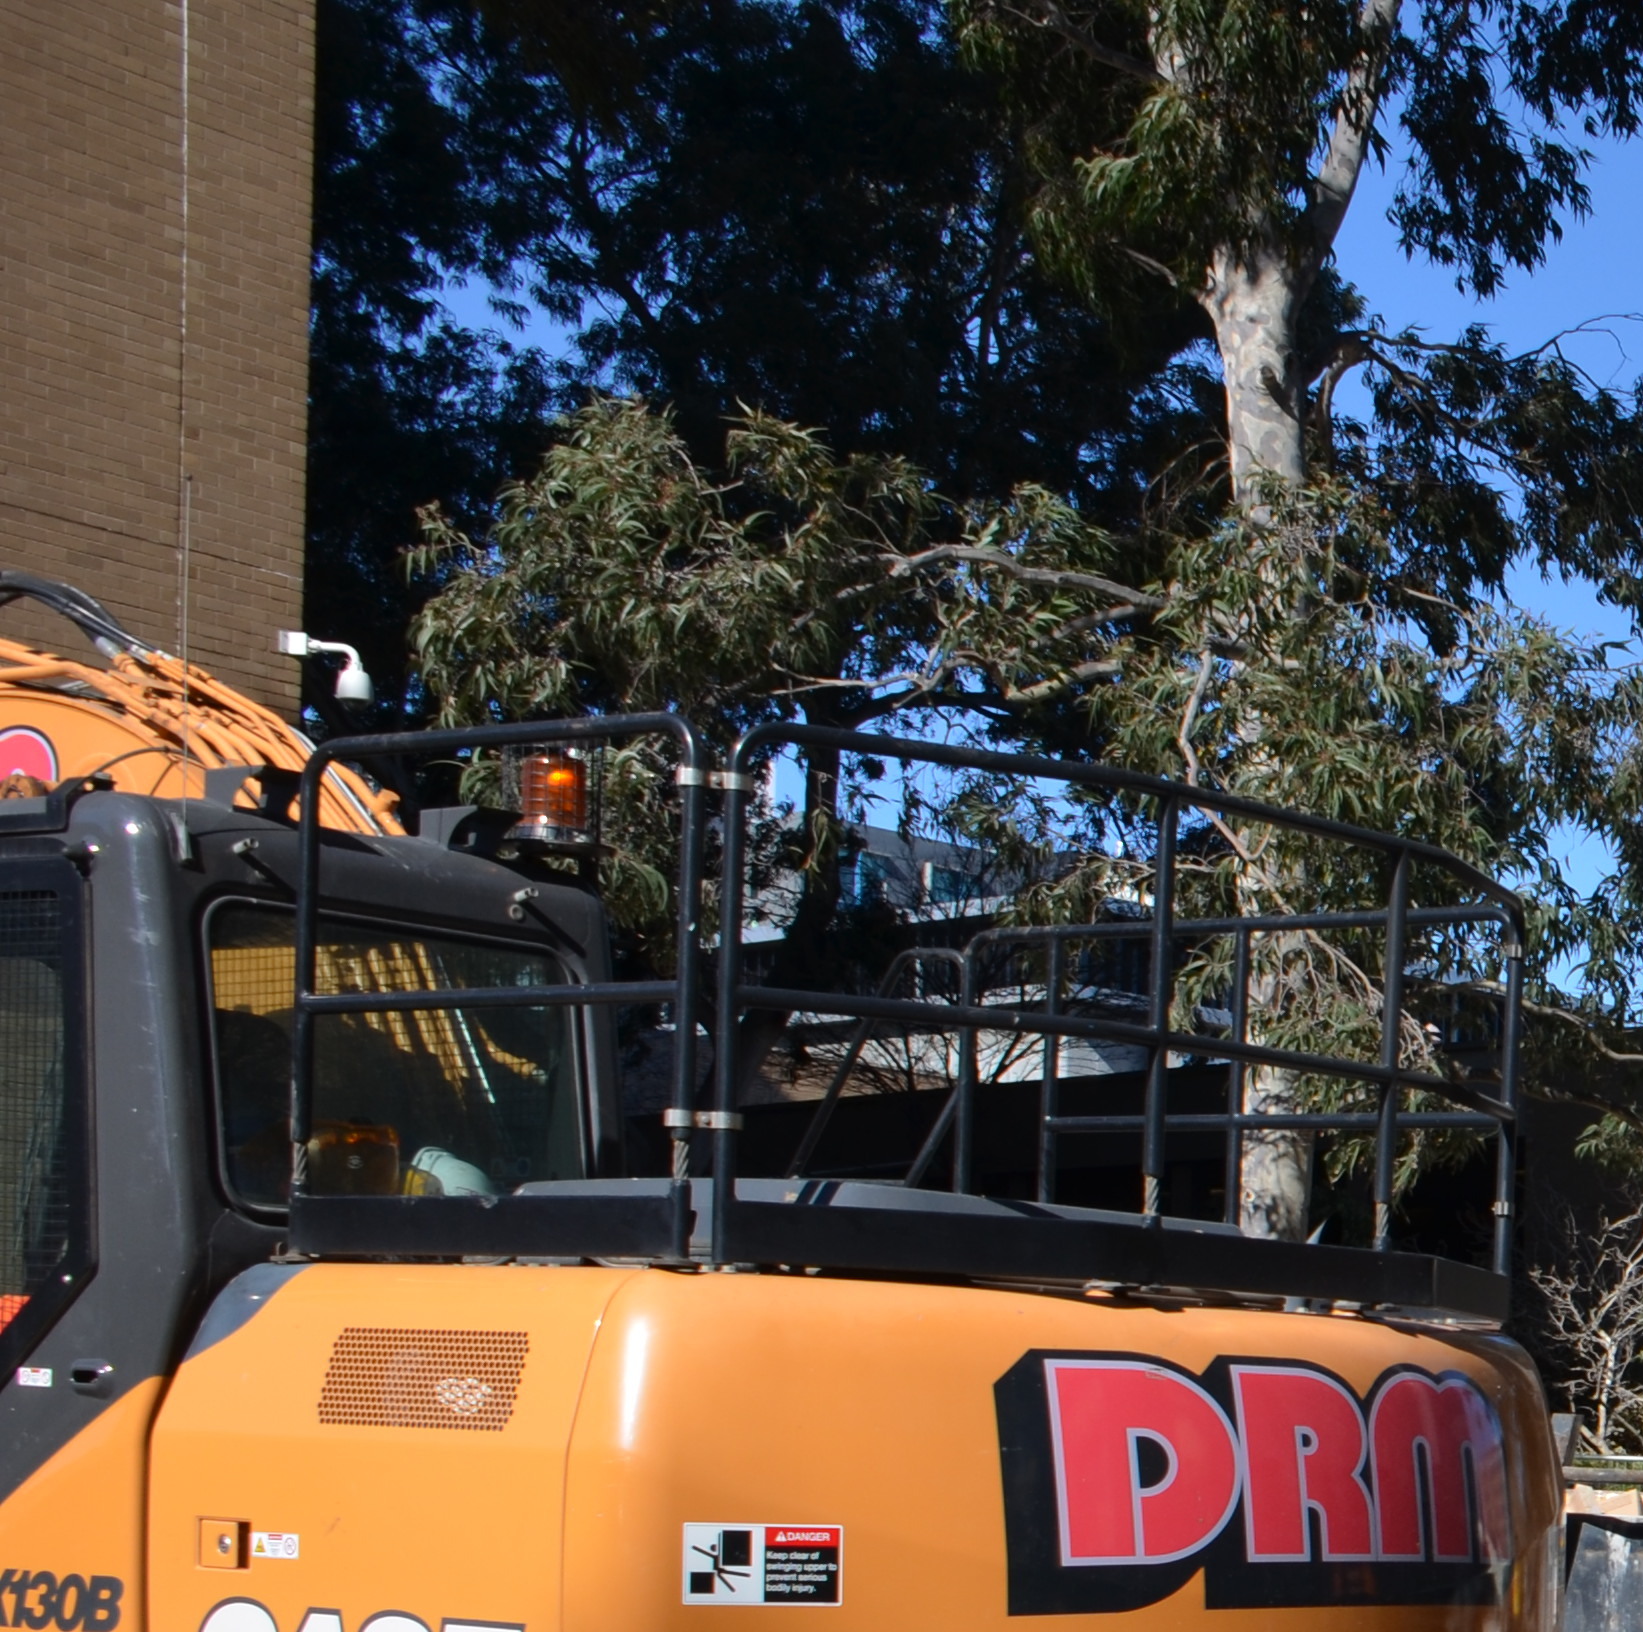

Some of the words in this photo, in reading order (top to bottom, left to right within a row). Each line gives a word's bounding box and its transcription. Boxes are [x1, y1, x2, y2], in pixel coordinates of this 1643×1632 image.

[1043, 1358, 1512, 1567] DRM
[786, 1531, 831, 1542] DANGER
[766, 1550, 789, 1561] Keep
[789, 1551, 810, 1560] clear
[810, 1551, 820, 1560] of
[766, 1561, 803, 1572] swinging
[803, 1563, 827, 1572] upper
[827, 1562, 838, 1571] to
[766, 1573, 797, 1582] prevent
[797, 1573, 828, 1581] serious
[766, 1583, 791, 1593] bodily
[791, 1583, 817, 1594] injury.
